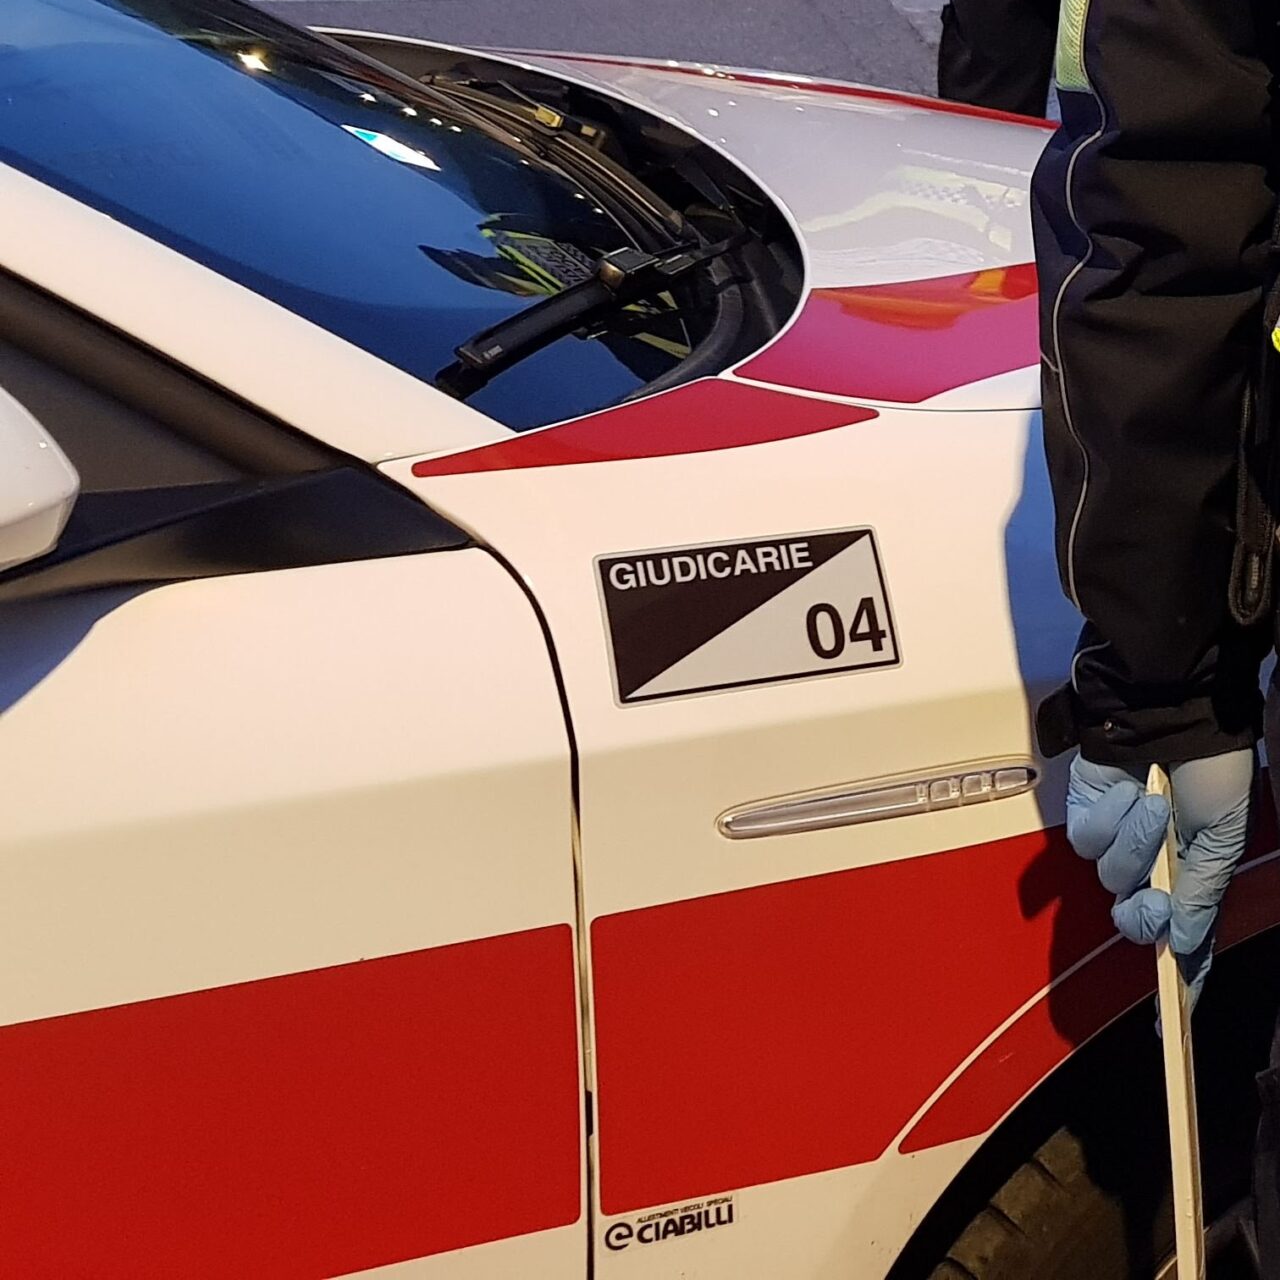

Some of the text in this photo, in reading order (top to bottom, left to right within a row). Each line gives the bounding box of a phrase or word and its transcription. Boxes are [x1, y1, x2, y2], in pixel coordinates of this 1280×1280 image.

[608, 541, 814, 591] GIUDICARIE
[805, 596, 887, 660] 04
[636, 1203, 734, 1243] CIABILLI
